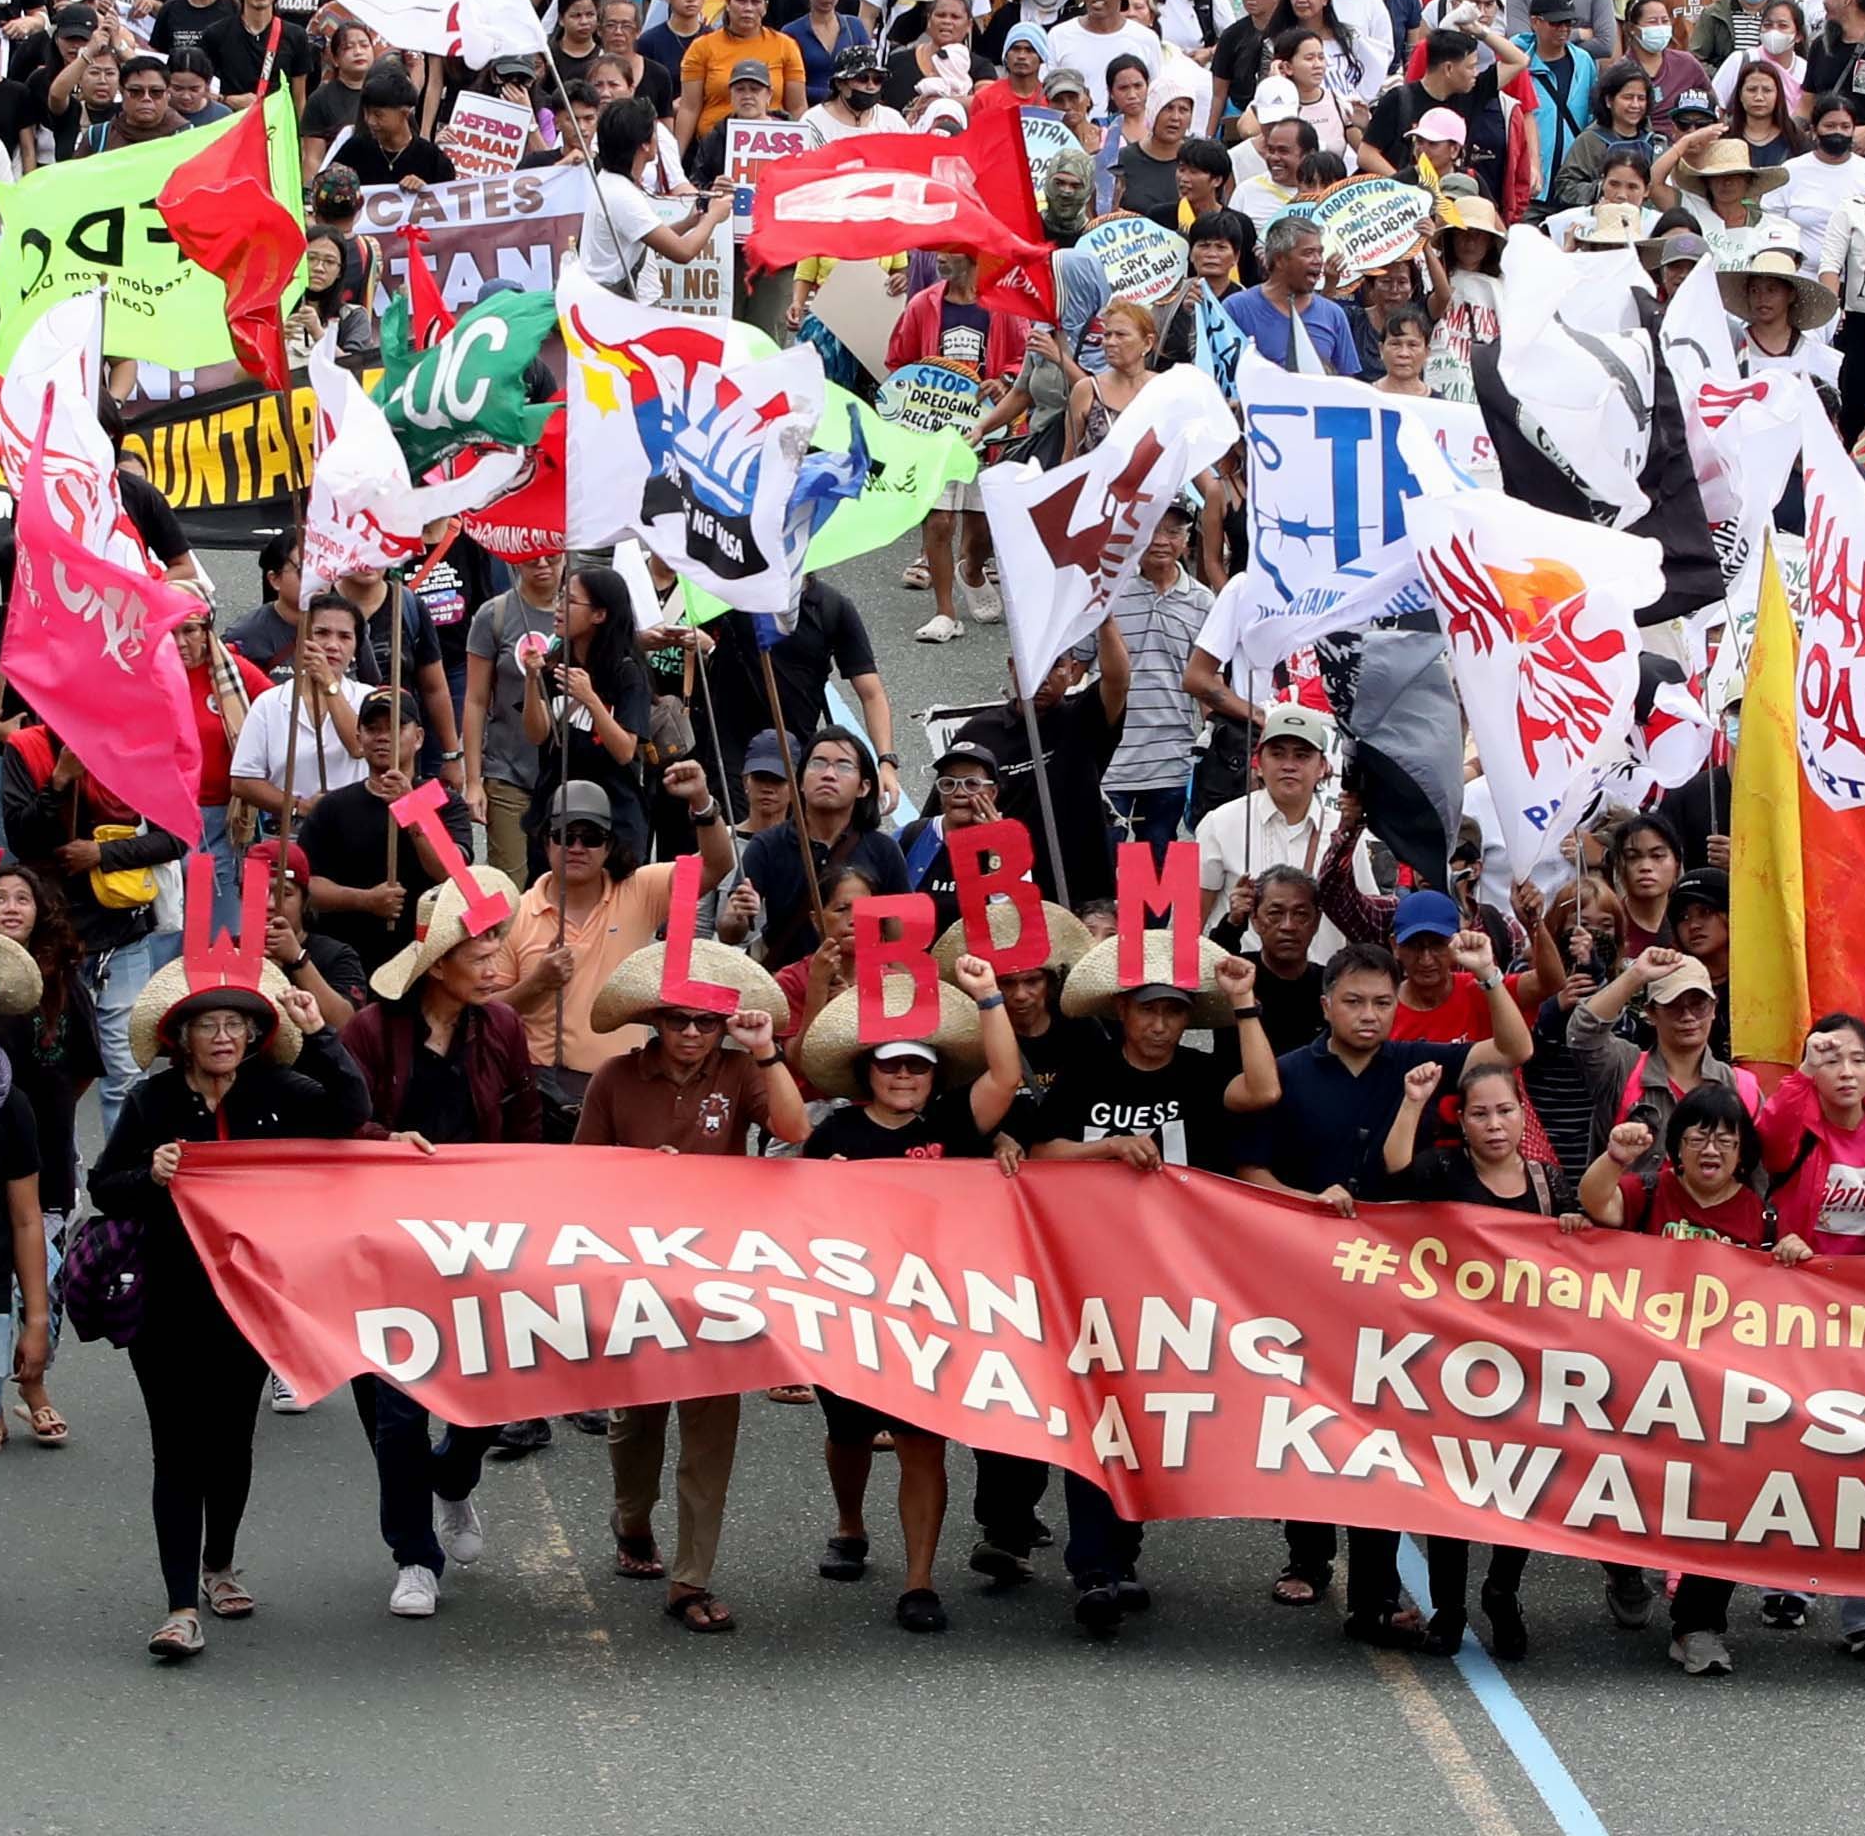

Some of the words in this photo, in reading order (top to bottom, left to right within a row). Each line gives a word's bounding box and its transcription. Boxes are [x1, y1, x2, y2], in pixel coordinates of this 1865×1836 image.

[455, 109, 524, 141] DEFEND
[733, 130, 805, 153] PASS
[1318, 179, 1396, 221] KARAPATAN
[1348, 201, 1367, 217] SA
[1089, 227, 1118, 252] NO
[1120, 219, 1146, 239] TO
[1345, 202, 1422, 256] IPAGLABAN!
[1118, 252, 1150, 277] SAVE
[1151, 250, 1181, 280] BAY!
[913, 367, 970, 393] STOP
[911, 389, 979, 418] DREDGING
[929, 409, 954, 422] AND
[947, 818, 1052, 978] B
[1115, 840, 1202, 990] M
[659, 855, 740, 1015] L
[852, 892, 941, 1045] B
[1089, 1100, 1181, 1128] GUESS
[396, 1217, 1044, 1345] WAKASAN
[1067, 1294, 1307, 1386] ANG
[355, 1276, 1070, 1439] DINASTIYA,
[1091, 1392, 1217, 1471] AT
